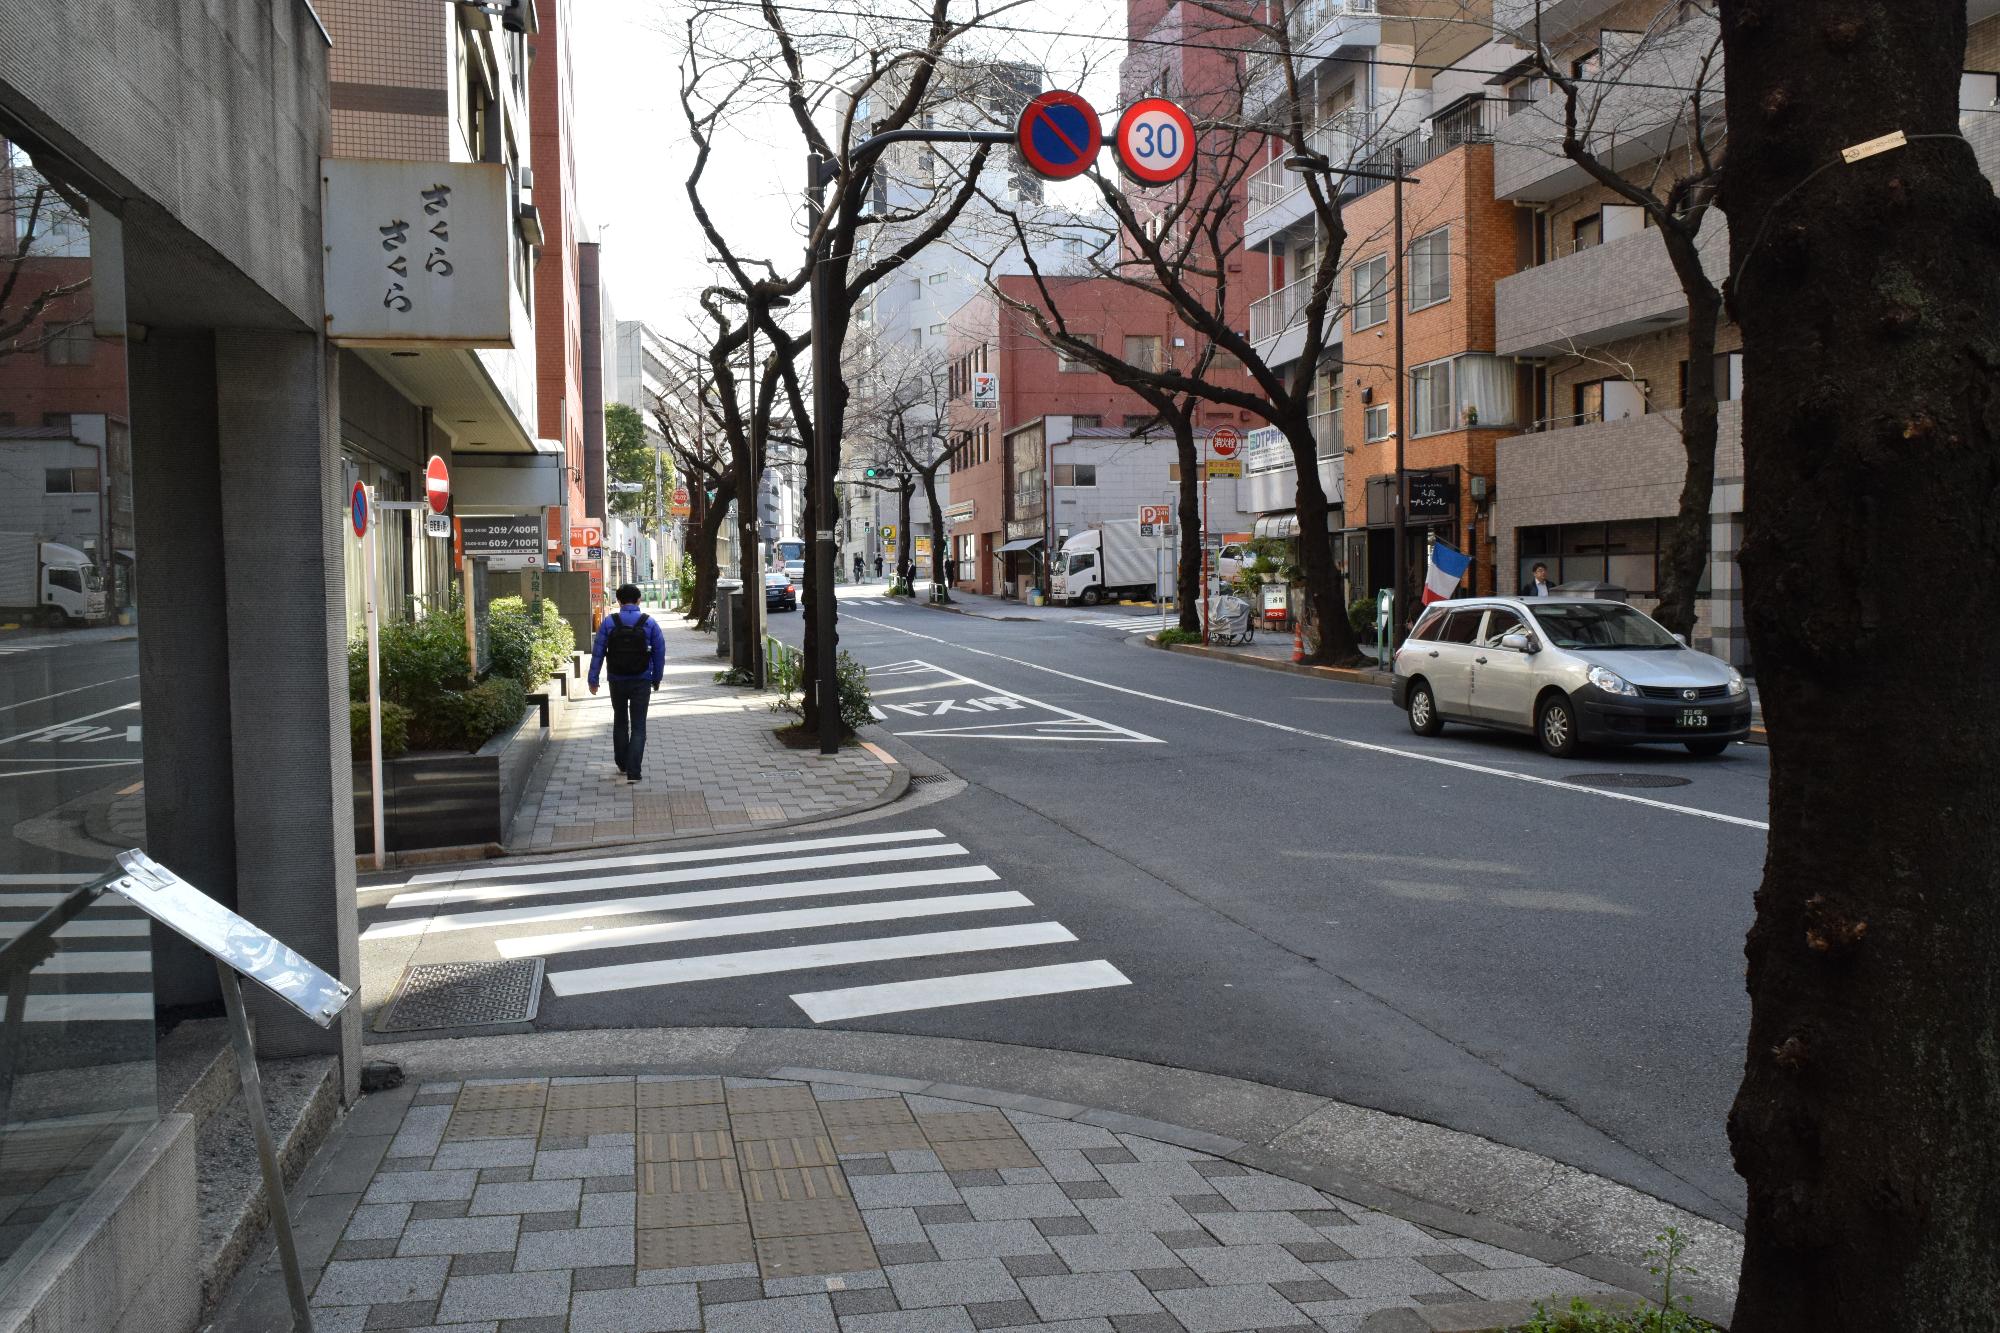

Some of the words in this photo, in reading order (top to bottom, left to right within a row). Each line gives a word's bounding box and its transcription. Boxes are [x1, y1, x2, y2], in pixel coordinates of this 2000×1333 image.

[1135, 122, 1178, 160] 30
[420, 183, 454, 277] さくら
[379, 218, 413, 313] さくら
[1214, 437, 1235, 448] 消火栓
[1142, 507, 1156, 523] P
[582, 528, 600, 545] P
[1683, 715, 1708, 726] 14-39
